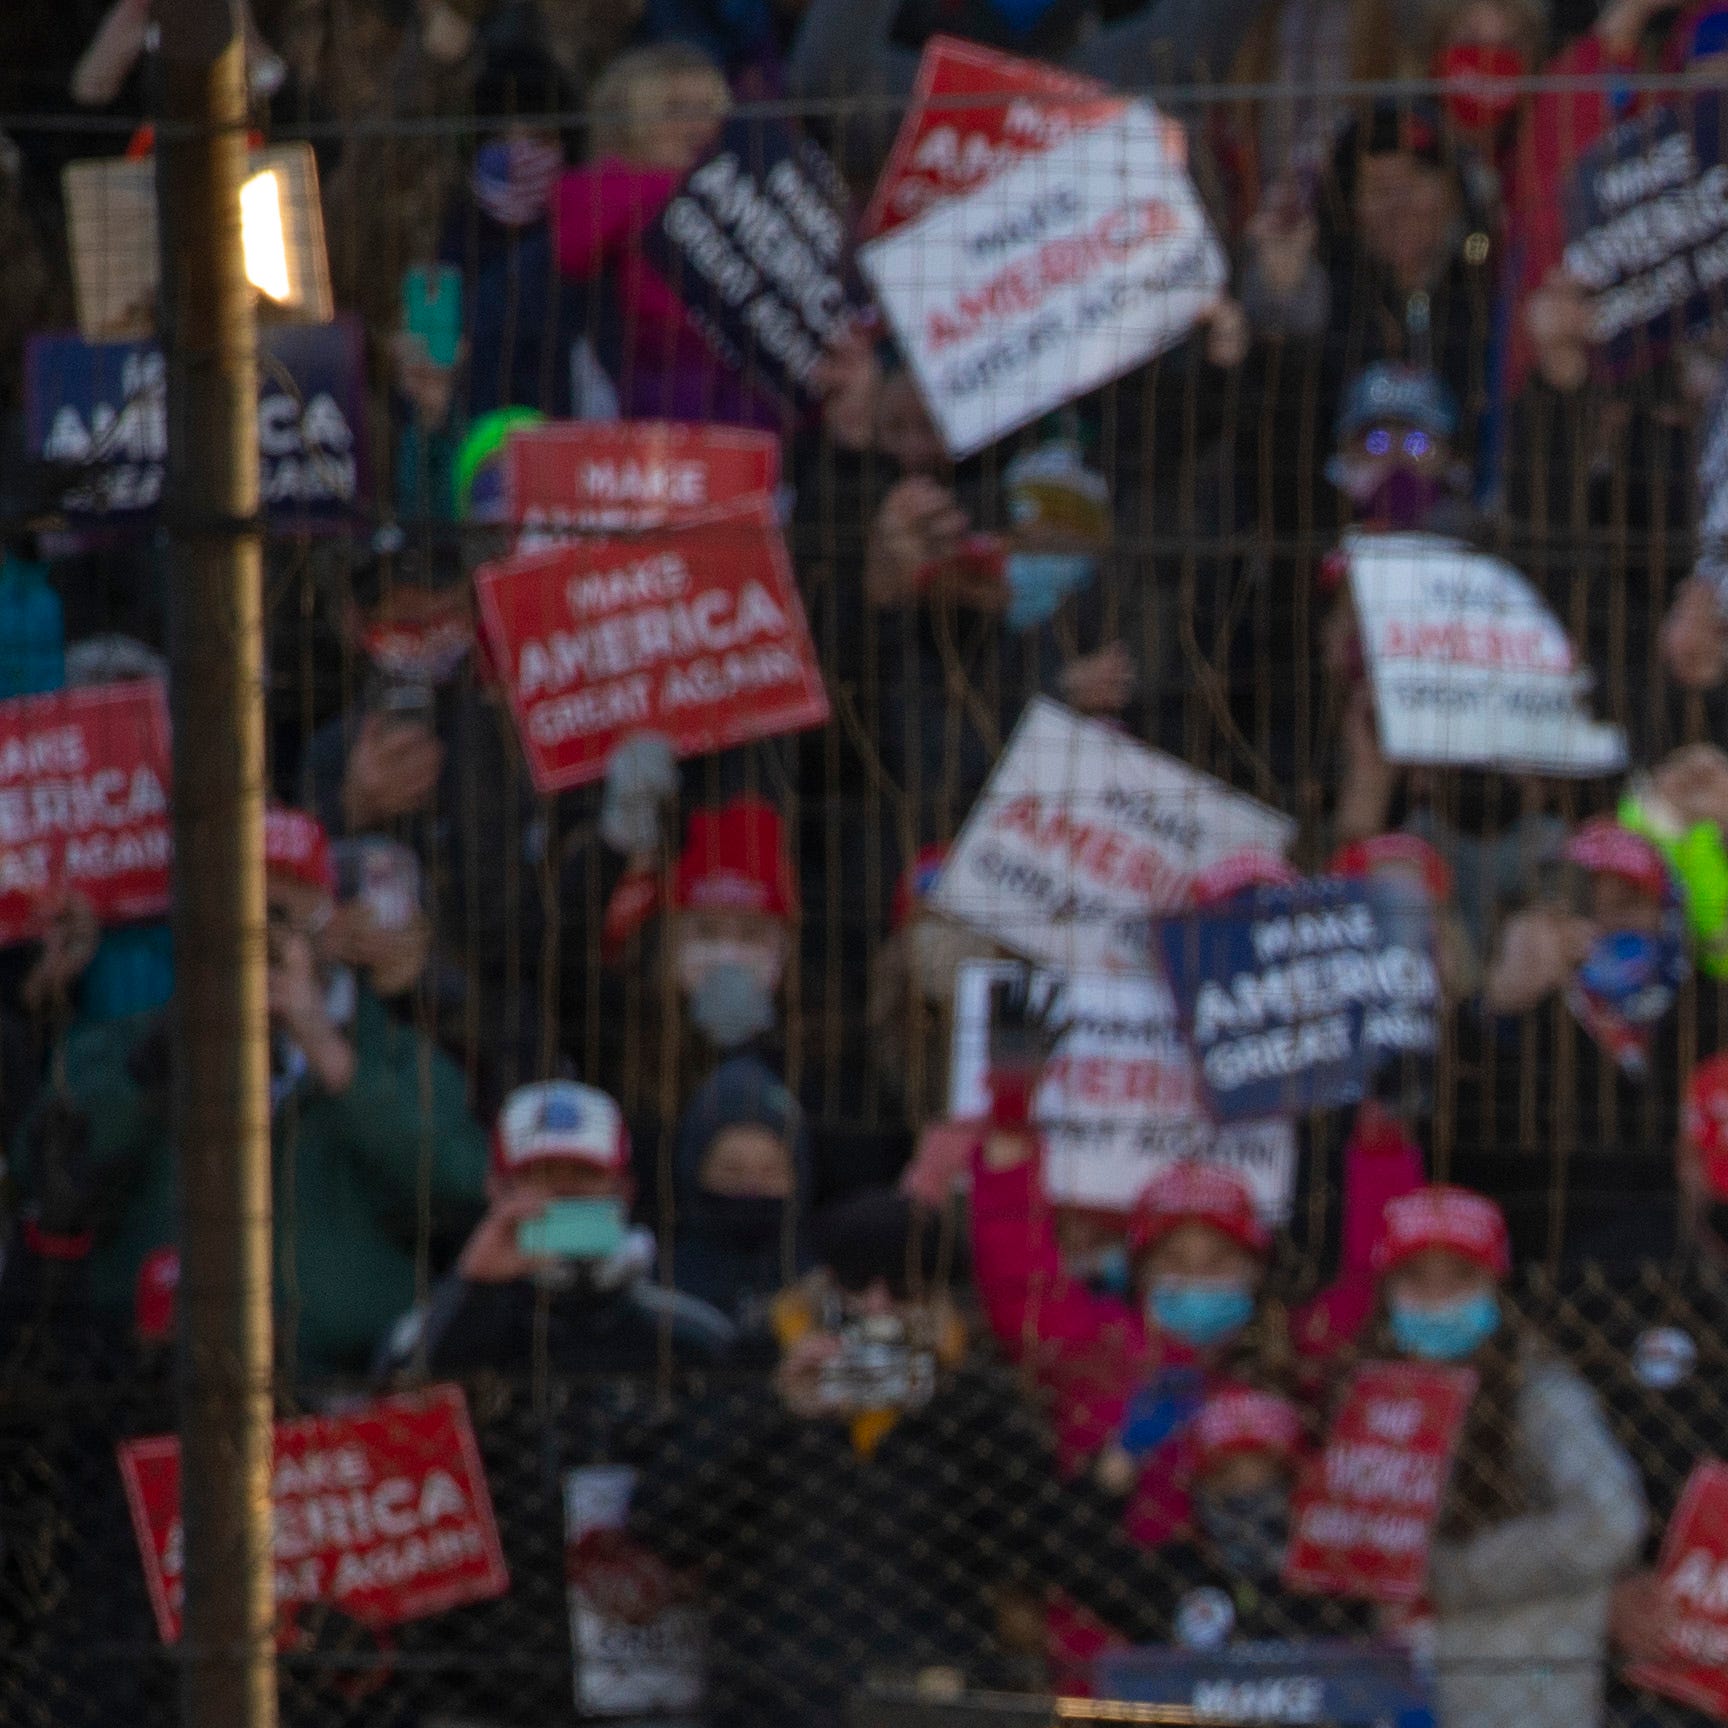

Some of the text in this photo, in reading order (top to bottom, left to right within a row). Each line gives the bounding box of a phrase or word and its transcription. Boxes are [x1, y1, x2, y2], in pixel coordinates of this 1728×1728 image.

[925, 202, 1184, 352] AMERICA
[577, 458, 707, 506] MAKE
[566, 550, 691, 613] MAKE
[516, 579, 788, 694] AMERICA
[526, 680, 654, 746] GREAT
[0, 722, 88, 776] AKE
[0, 764, 165, 840] ERICA
[1253, 903, 1377, 963] MAKE
[1207, 1015, 1353, 1091] GREAT
[272, 1444, 370, 1499] AKE
